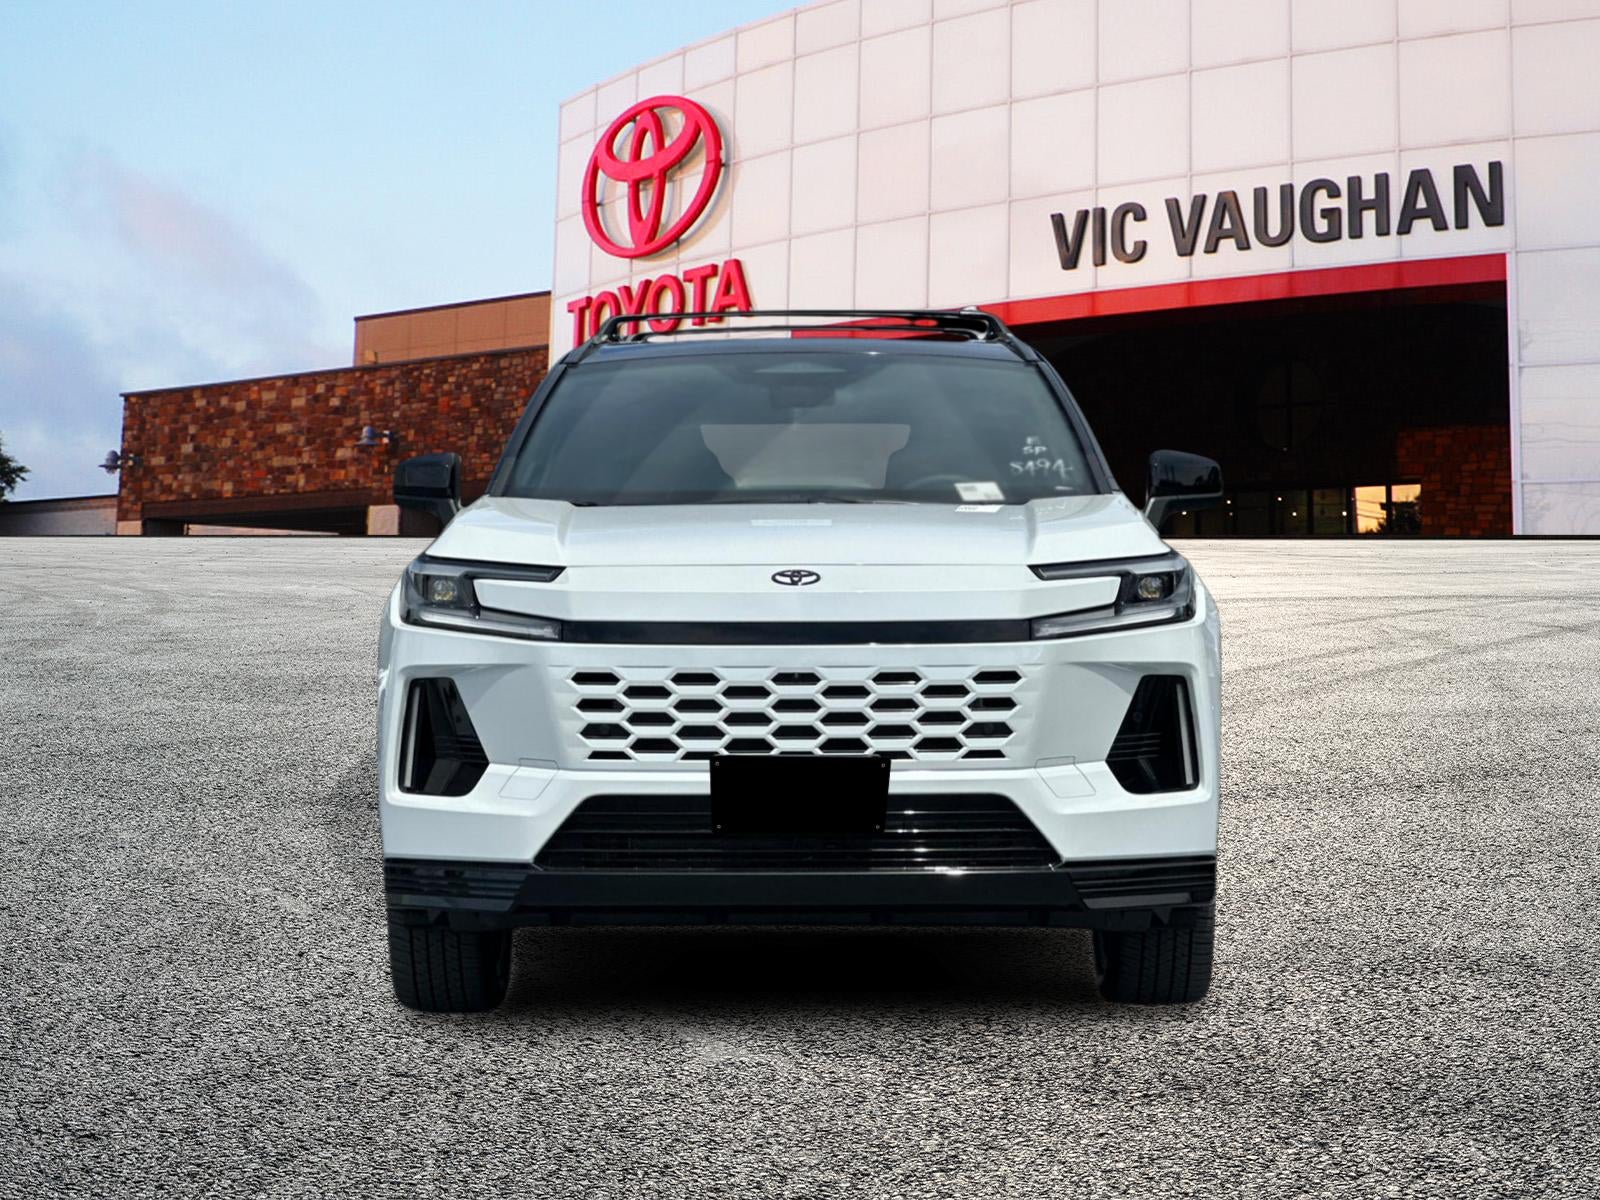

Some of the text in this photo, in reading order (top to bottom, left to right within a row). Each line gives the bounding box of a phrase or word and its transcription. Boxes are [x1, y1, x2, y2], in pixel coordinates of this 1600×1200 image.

[1050, 161, 1505, 271] VIC VAUGHAN
[567, 259, 752, 349] TOYOTA
